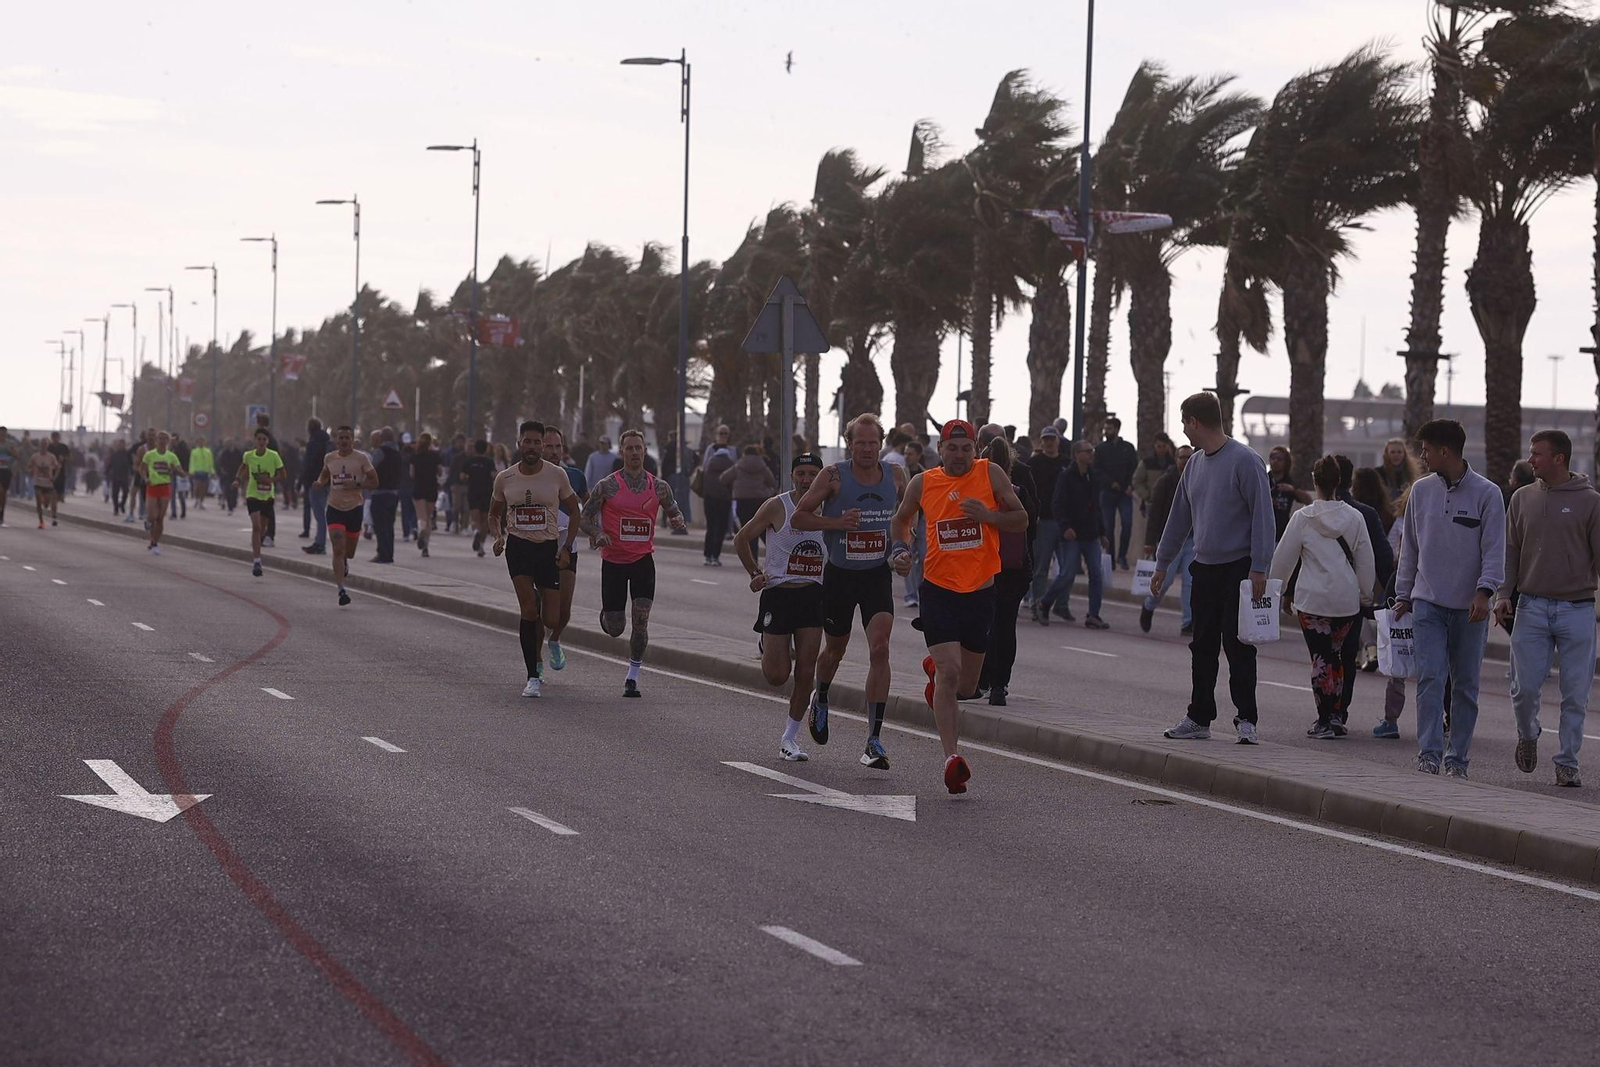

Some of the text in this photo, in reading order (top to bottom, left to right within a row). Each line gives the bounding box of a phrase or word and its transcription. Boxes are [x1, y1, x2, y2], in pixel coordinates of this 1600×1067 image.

[960, 527, 977, 537] 290
[868, 540, 883, 548] 718
[805, 564, 822, 572] 1309
